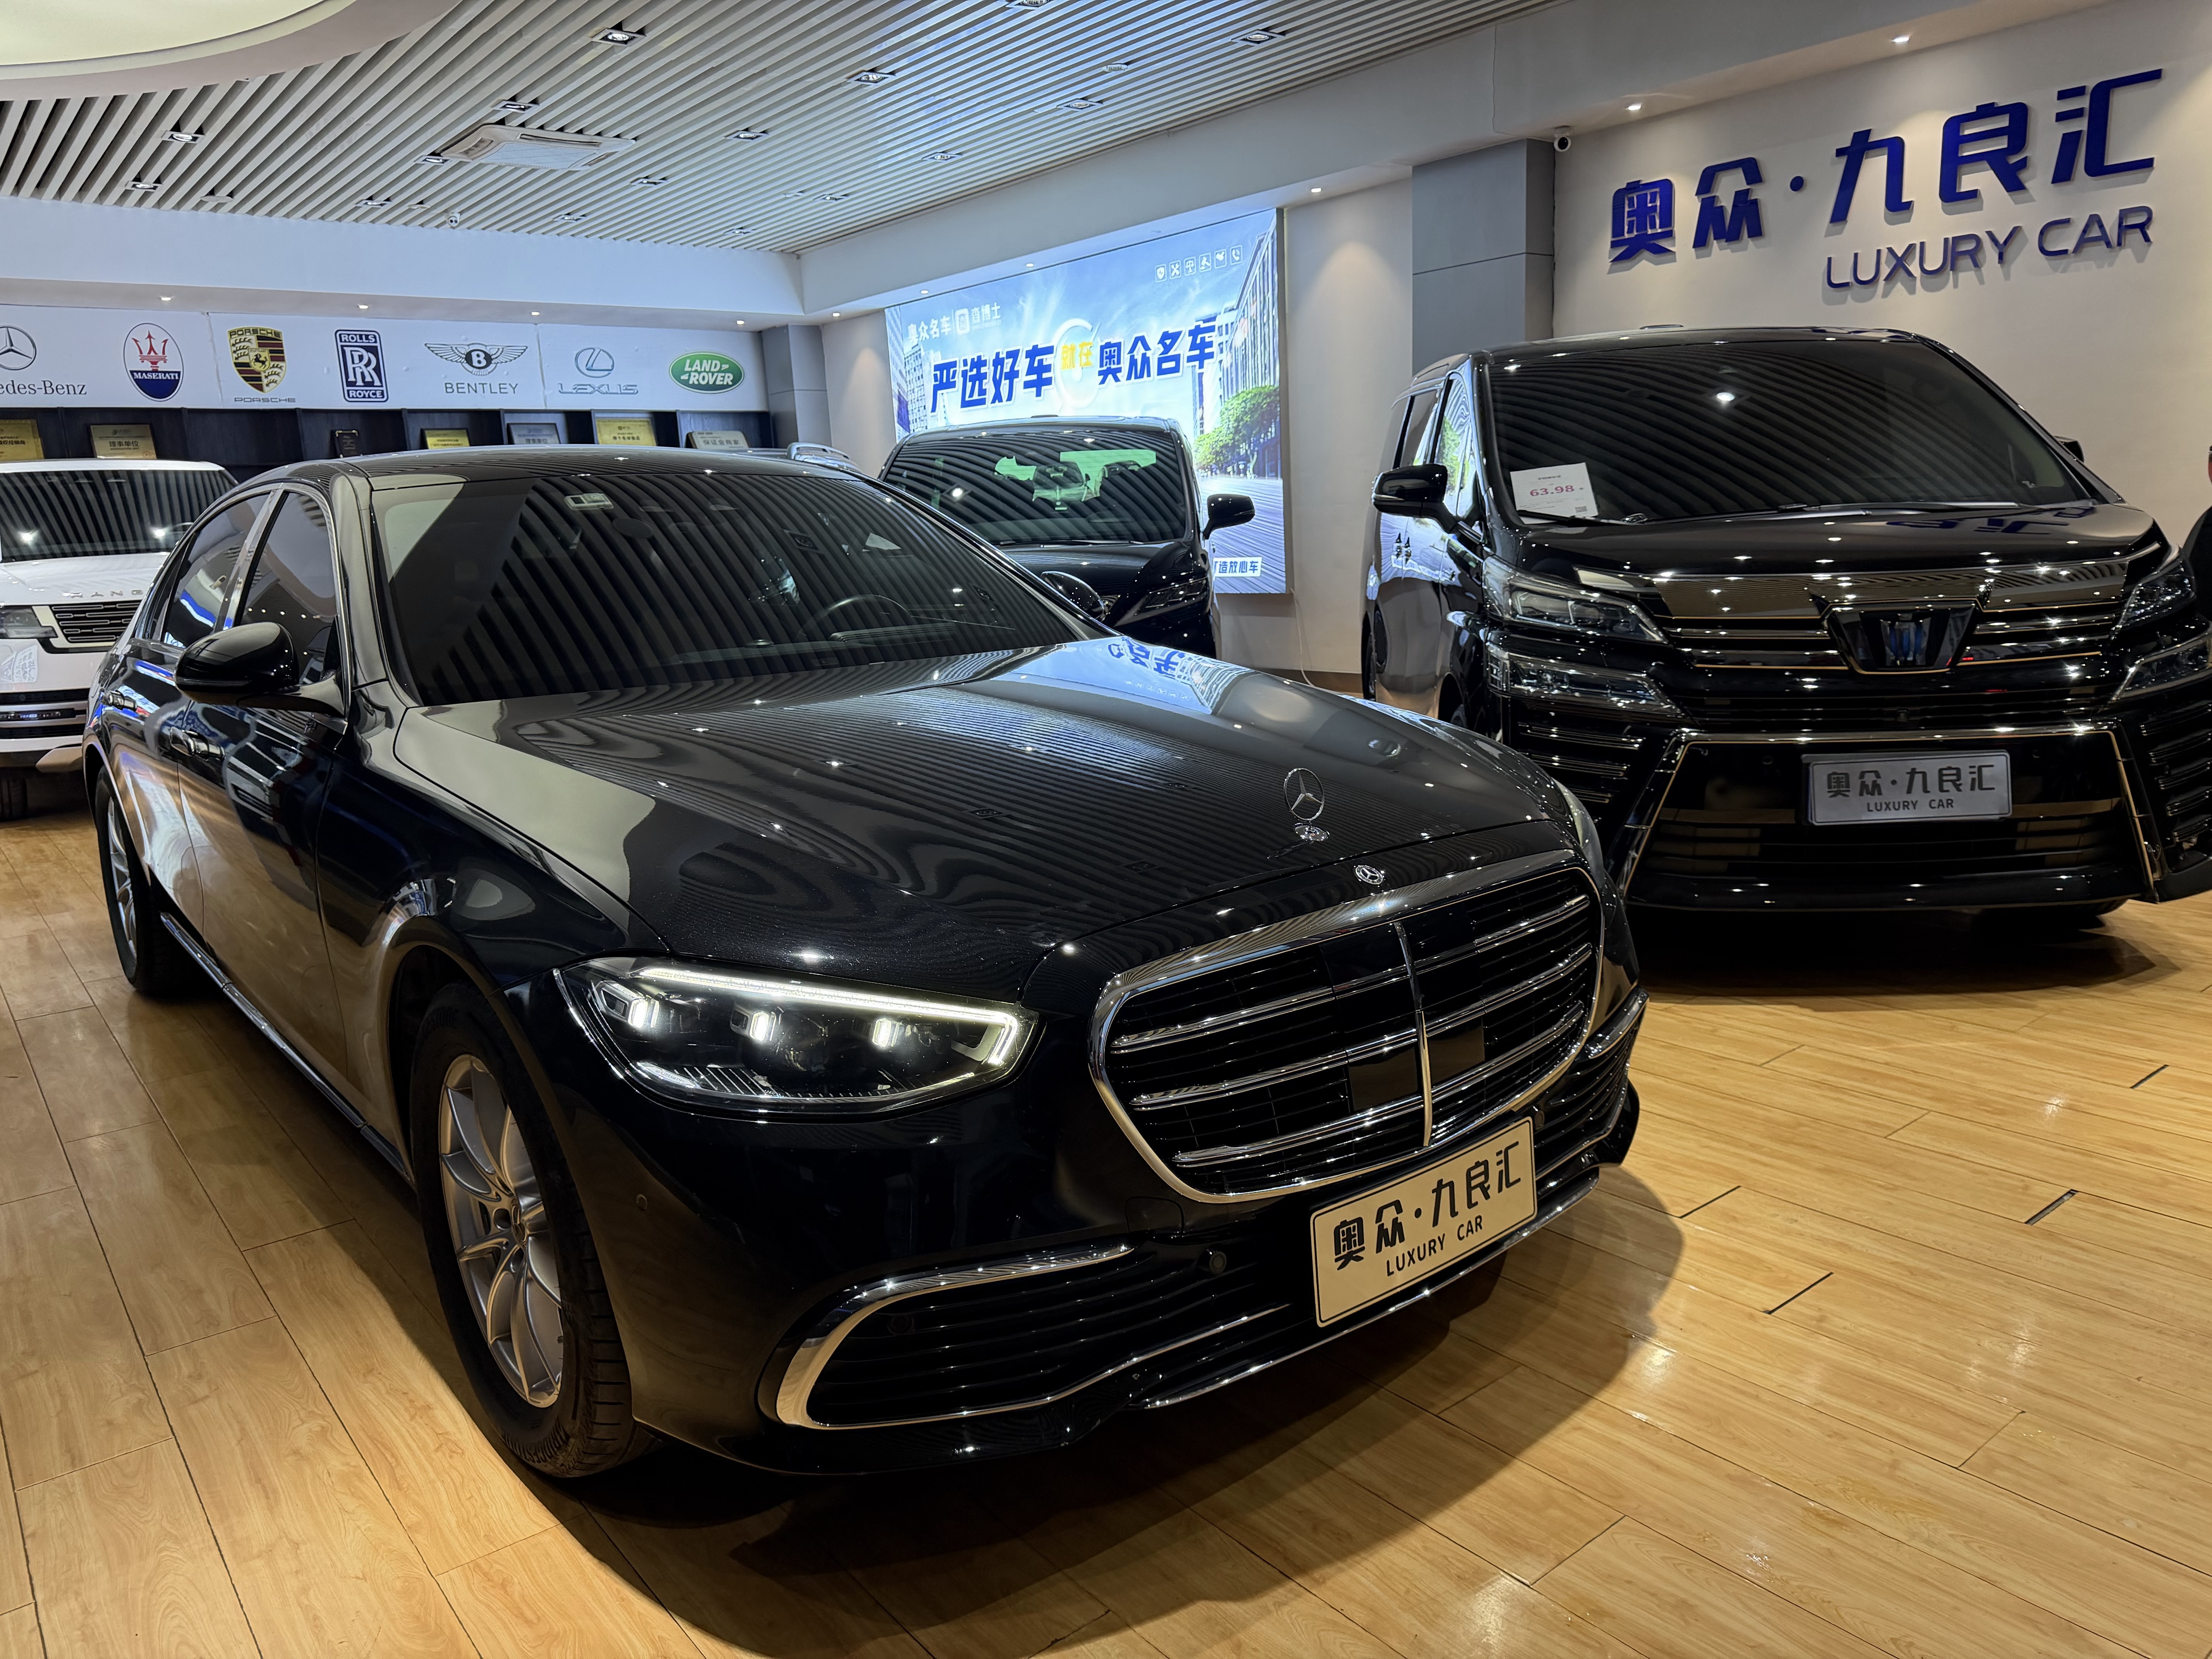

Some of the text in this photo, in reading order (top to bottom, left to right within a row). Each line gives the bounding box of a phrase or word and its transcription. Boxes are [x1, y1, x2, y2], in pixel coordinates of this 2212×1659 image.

[1610, 69, 2163, 262] 奥众·九良汇
[1826, 205, 2154, 289] LUXURY CAR
[229, 328, 281, 339] PORSCHE
[908, 315, 951, 345] 奥众名车
[341, 333, 375, 343] ROLLS
[684, 359, 720, 372] LAND
[930, 344, 1054, 413] 严选好车
[1097, 323, 1216, 385] 奥众名车
[133, 372, 179, 380] MASERATI
[689, 372, 733, 385] ROVER
[349, 389, 383, 399] ROYCE
[445, 382, 519, 394] BENTLEY
[558, 382, 638, 395] LEXUS
[1530, 485, 1574, 496] 63.98
[1827, 764, 1996, 798] 奥众·九良汇
[1867, 799, 1954, 812] LUXURY CAR
[1333, 1140, 1521, 1271] 奥众·九良汇
[1386, 1214, 1483, 1277] LUXURY CAR
